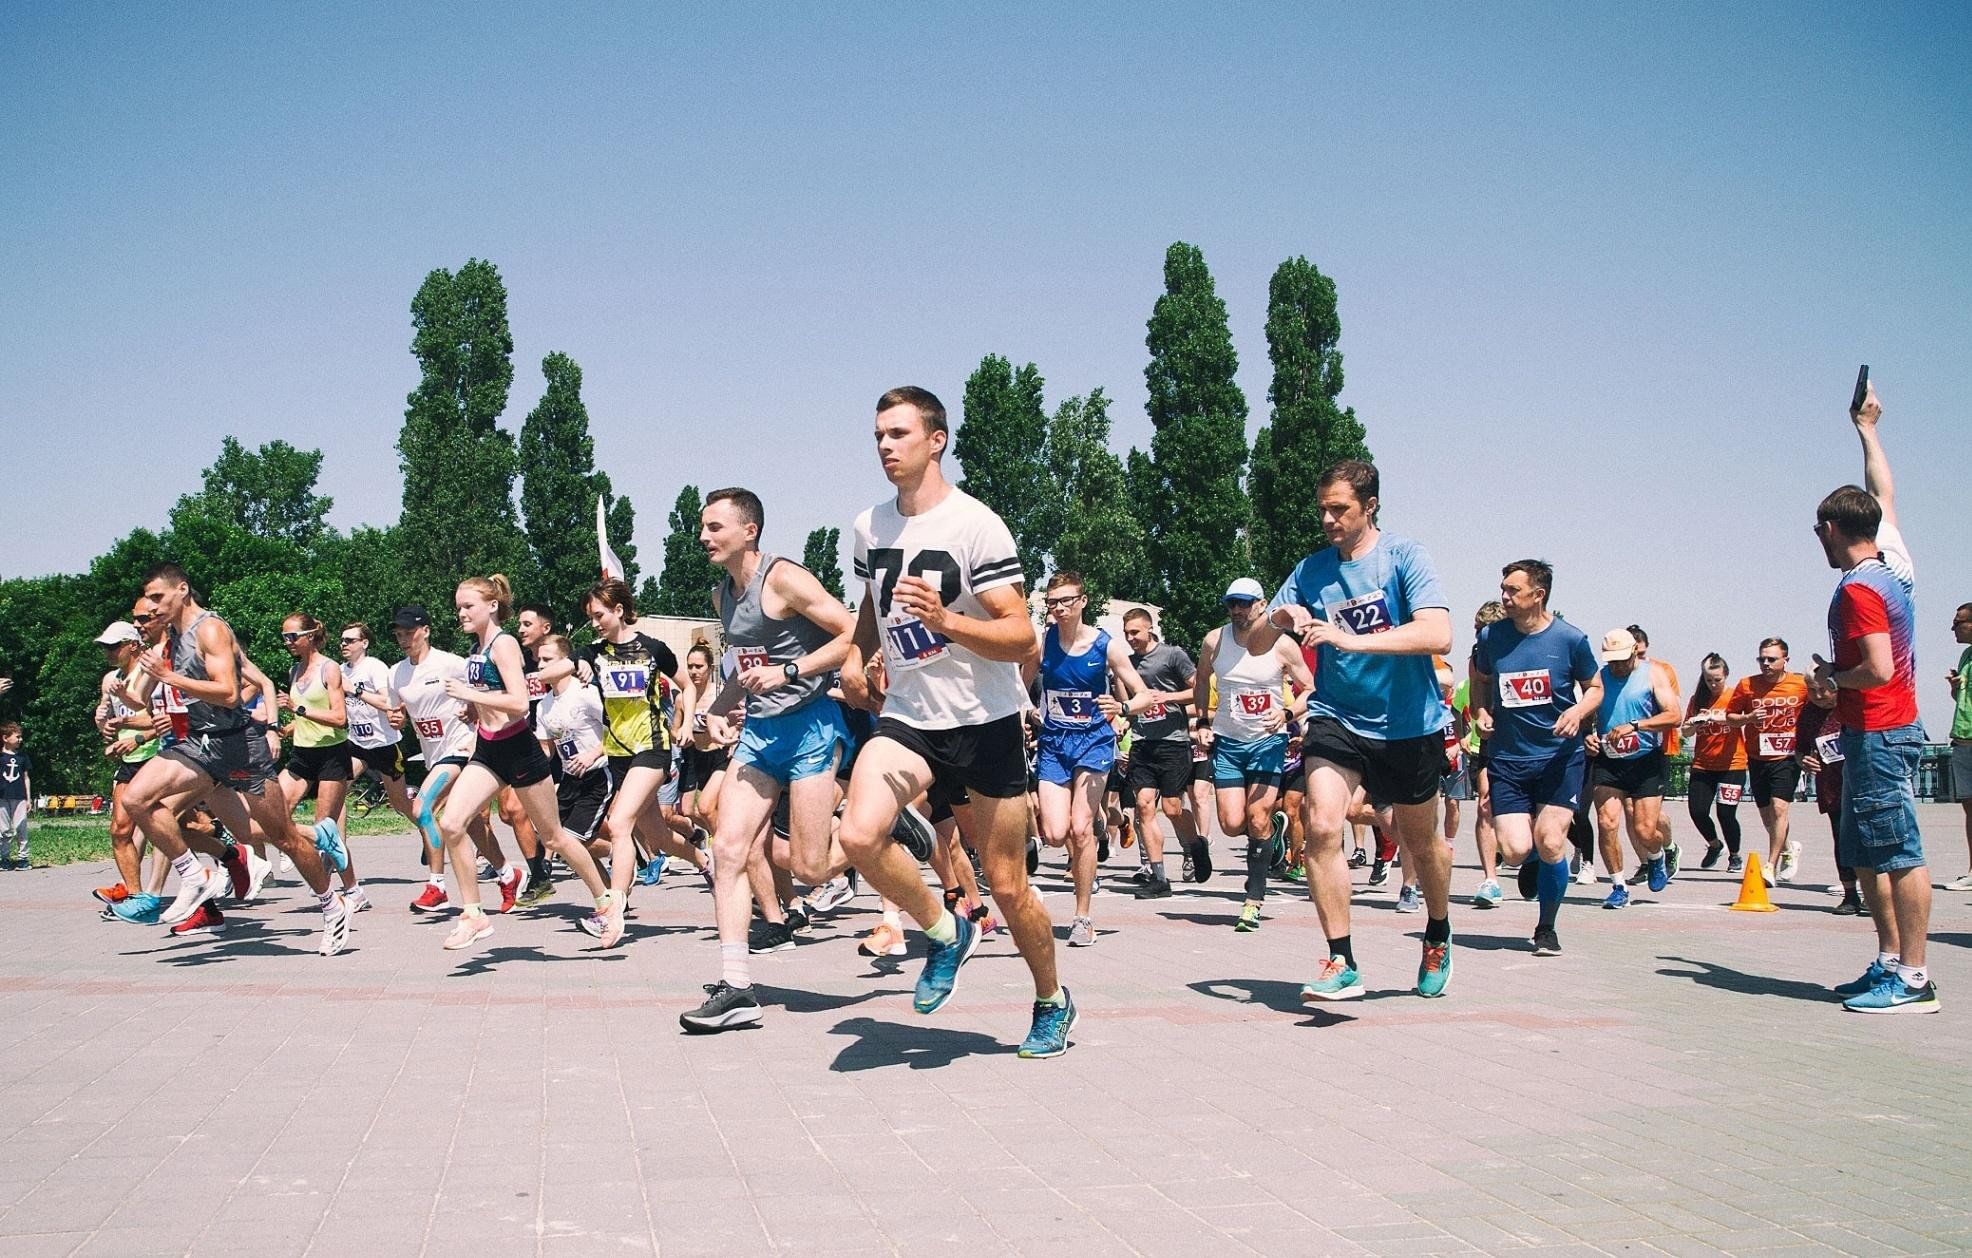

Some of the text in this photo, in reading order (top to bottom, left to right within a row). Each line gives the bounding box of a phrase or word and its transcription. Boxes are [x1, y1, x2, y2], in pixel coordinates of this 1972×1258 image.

[1353, 604, 1384, 629] 22
[892, 623, 937, 654] 111
[470, 662, 480, 680] 93
[618, 672, 636, 688] 91
[1521, 678, 1545, 695] 40
[1071, 699, 1081, 713] 3
[1248, 696, 1265, 711] 39
[1751, 696, 1799, 708] DODO
[421, 721, 439, 735] 35
[1443, 726, 1454, 736] 15
[562, 744, 571, 756] 9
[1617, 736, 1634, 750] 47
[1775, 738, 1791, 749] 57
[1724, 789, 1738, 800] 55
